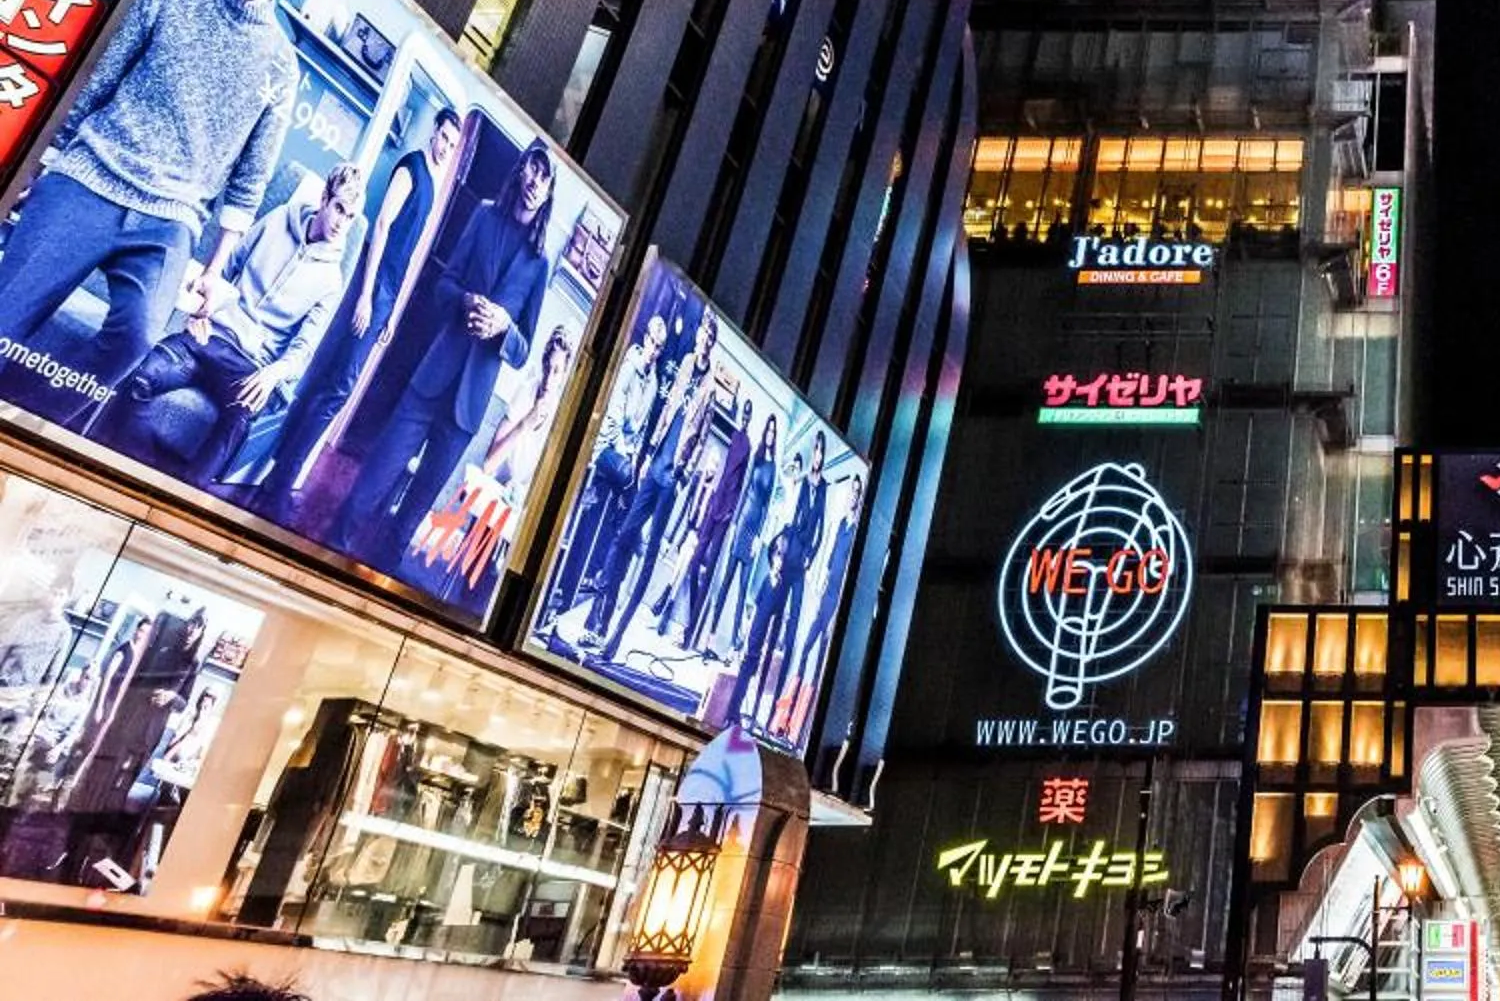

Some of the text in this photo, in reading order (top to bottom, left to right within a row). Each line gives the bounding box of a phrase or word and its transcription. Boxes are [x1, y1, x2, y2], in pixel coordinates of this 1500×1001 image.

[1068, 235, 1214, 268] J'adore
[1375, 263, 1392, 296] 6F
[1043, 372, 1203, 407] サイゼリヤ
[1447, 576, 1484, 597] SHIN
[975, 719, 1176, 746] WWW.WEGO.JP
[1039, 777, 1089, 824] 薬
